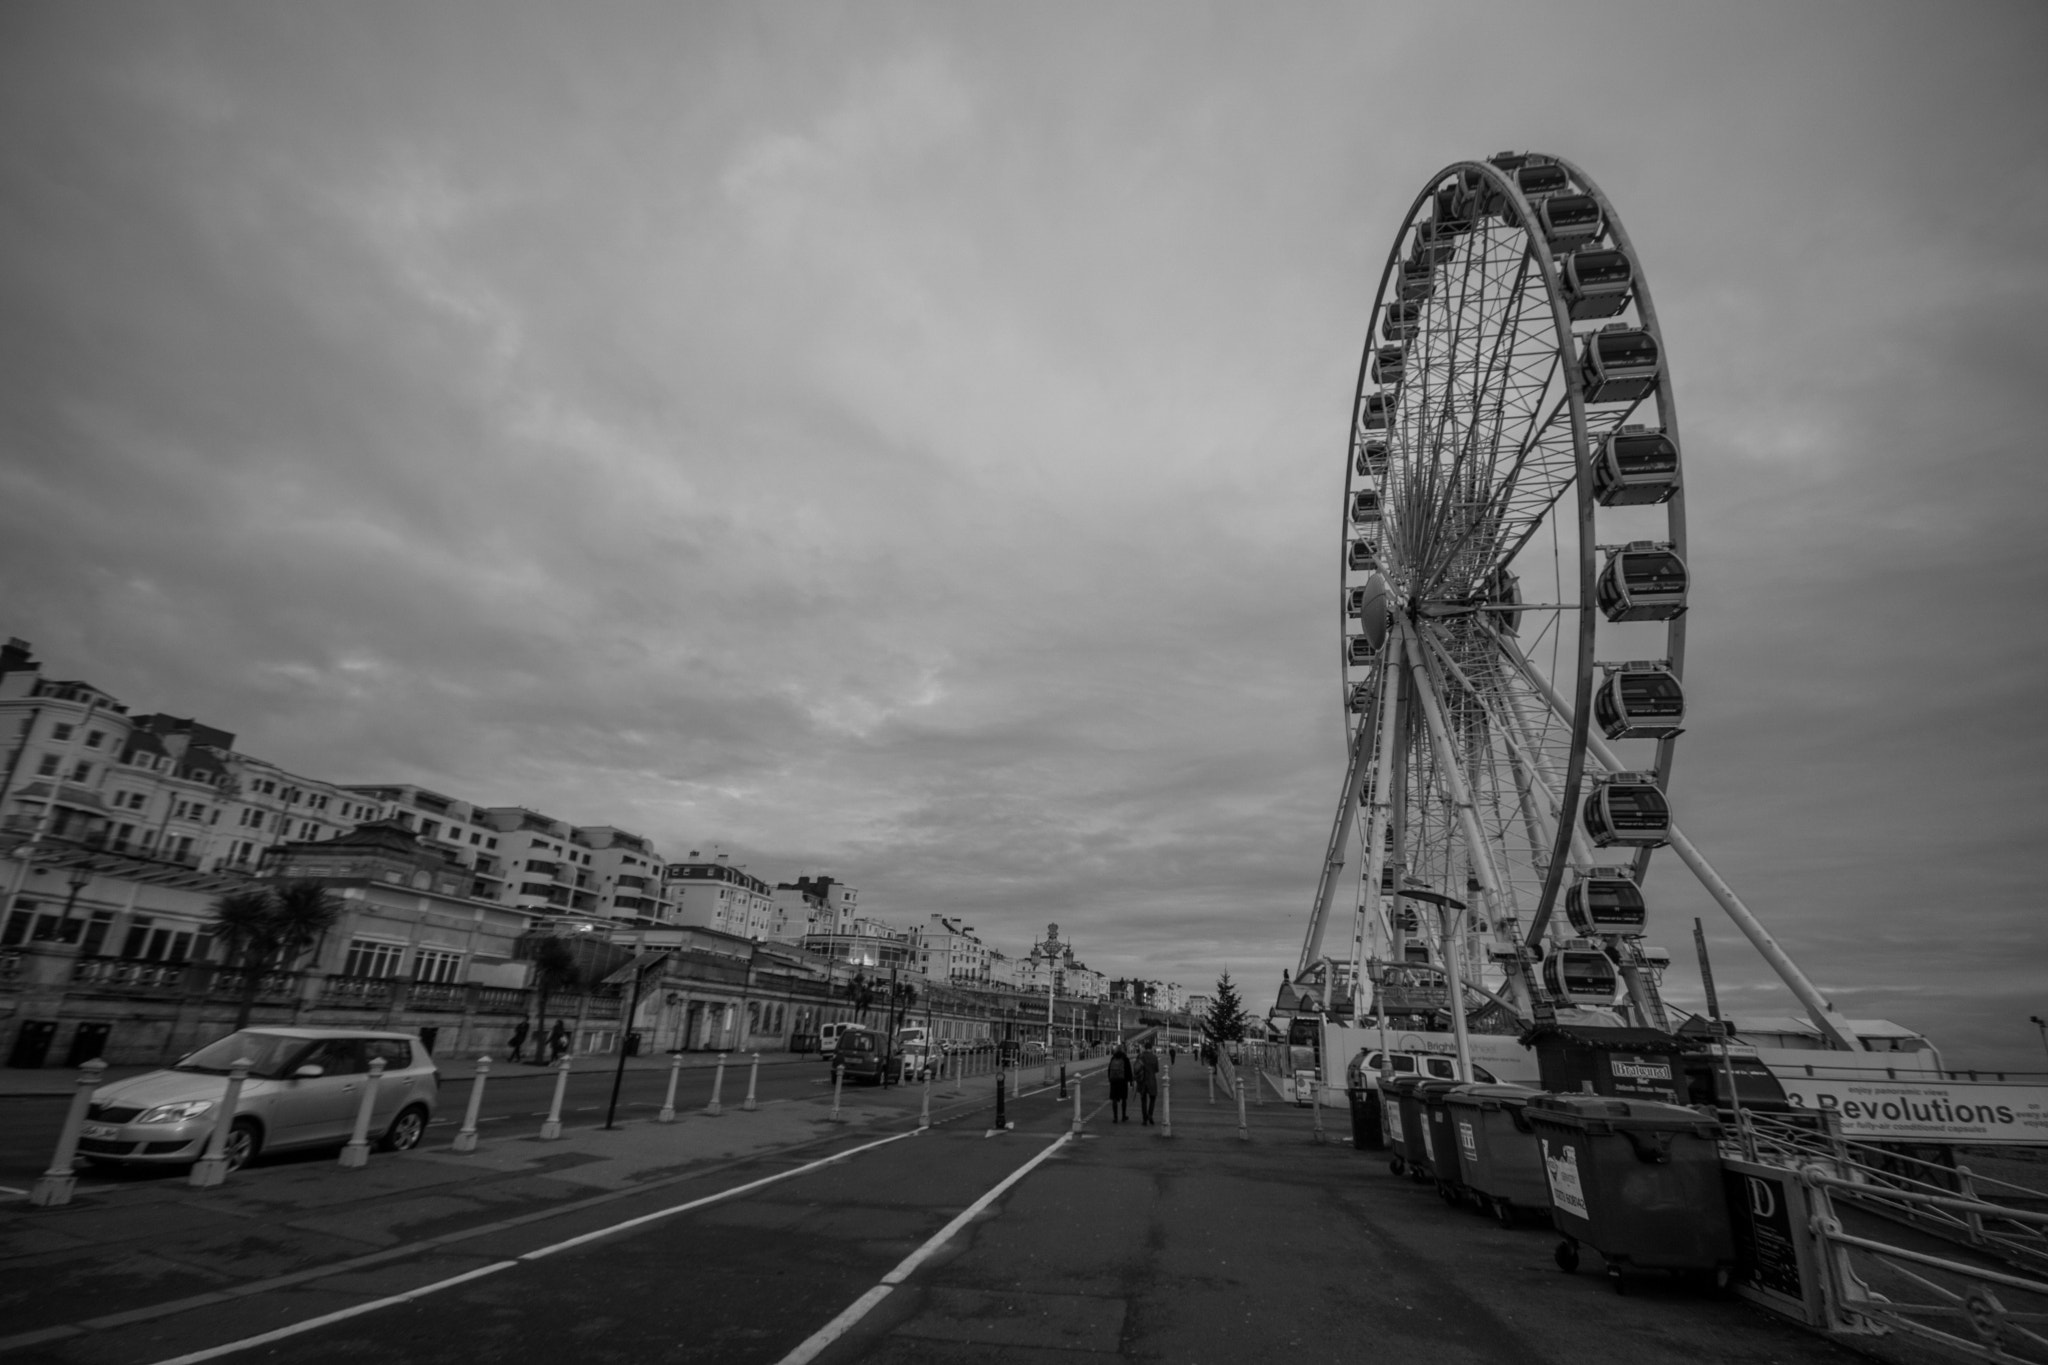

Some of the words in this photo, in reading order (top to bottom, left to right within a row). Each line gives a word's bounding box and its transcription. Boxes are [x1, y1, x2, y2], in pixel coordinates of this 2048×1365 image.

[1848, 1087, 1872, 1095] enjoy
[1874, 1088, 1921, 1096] panoramic
[1816, 1094, 2014, 1124] Revolutions
[1892, 1123, 1946, 1132] conditioned
[1948, 1124, 1988, 1133] capsules
[1748, 1176, 1776, 1218] D
